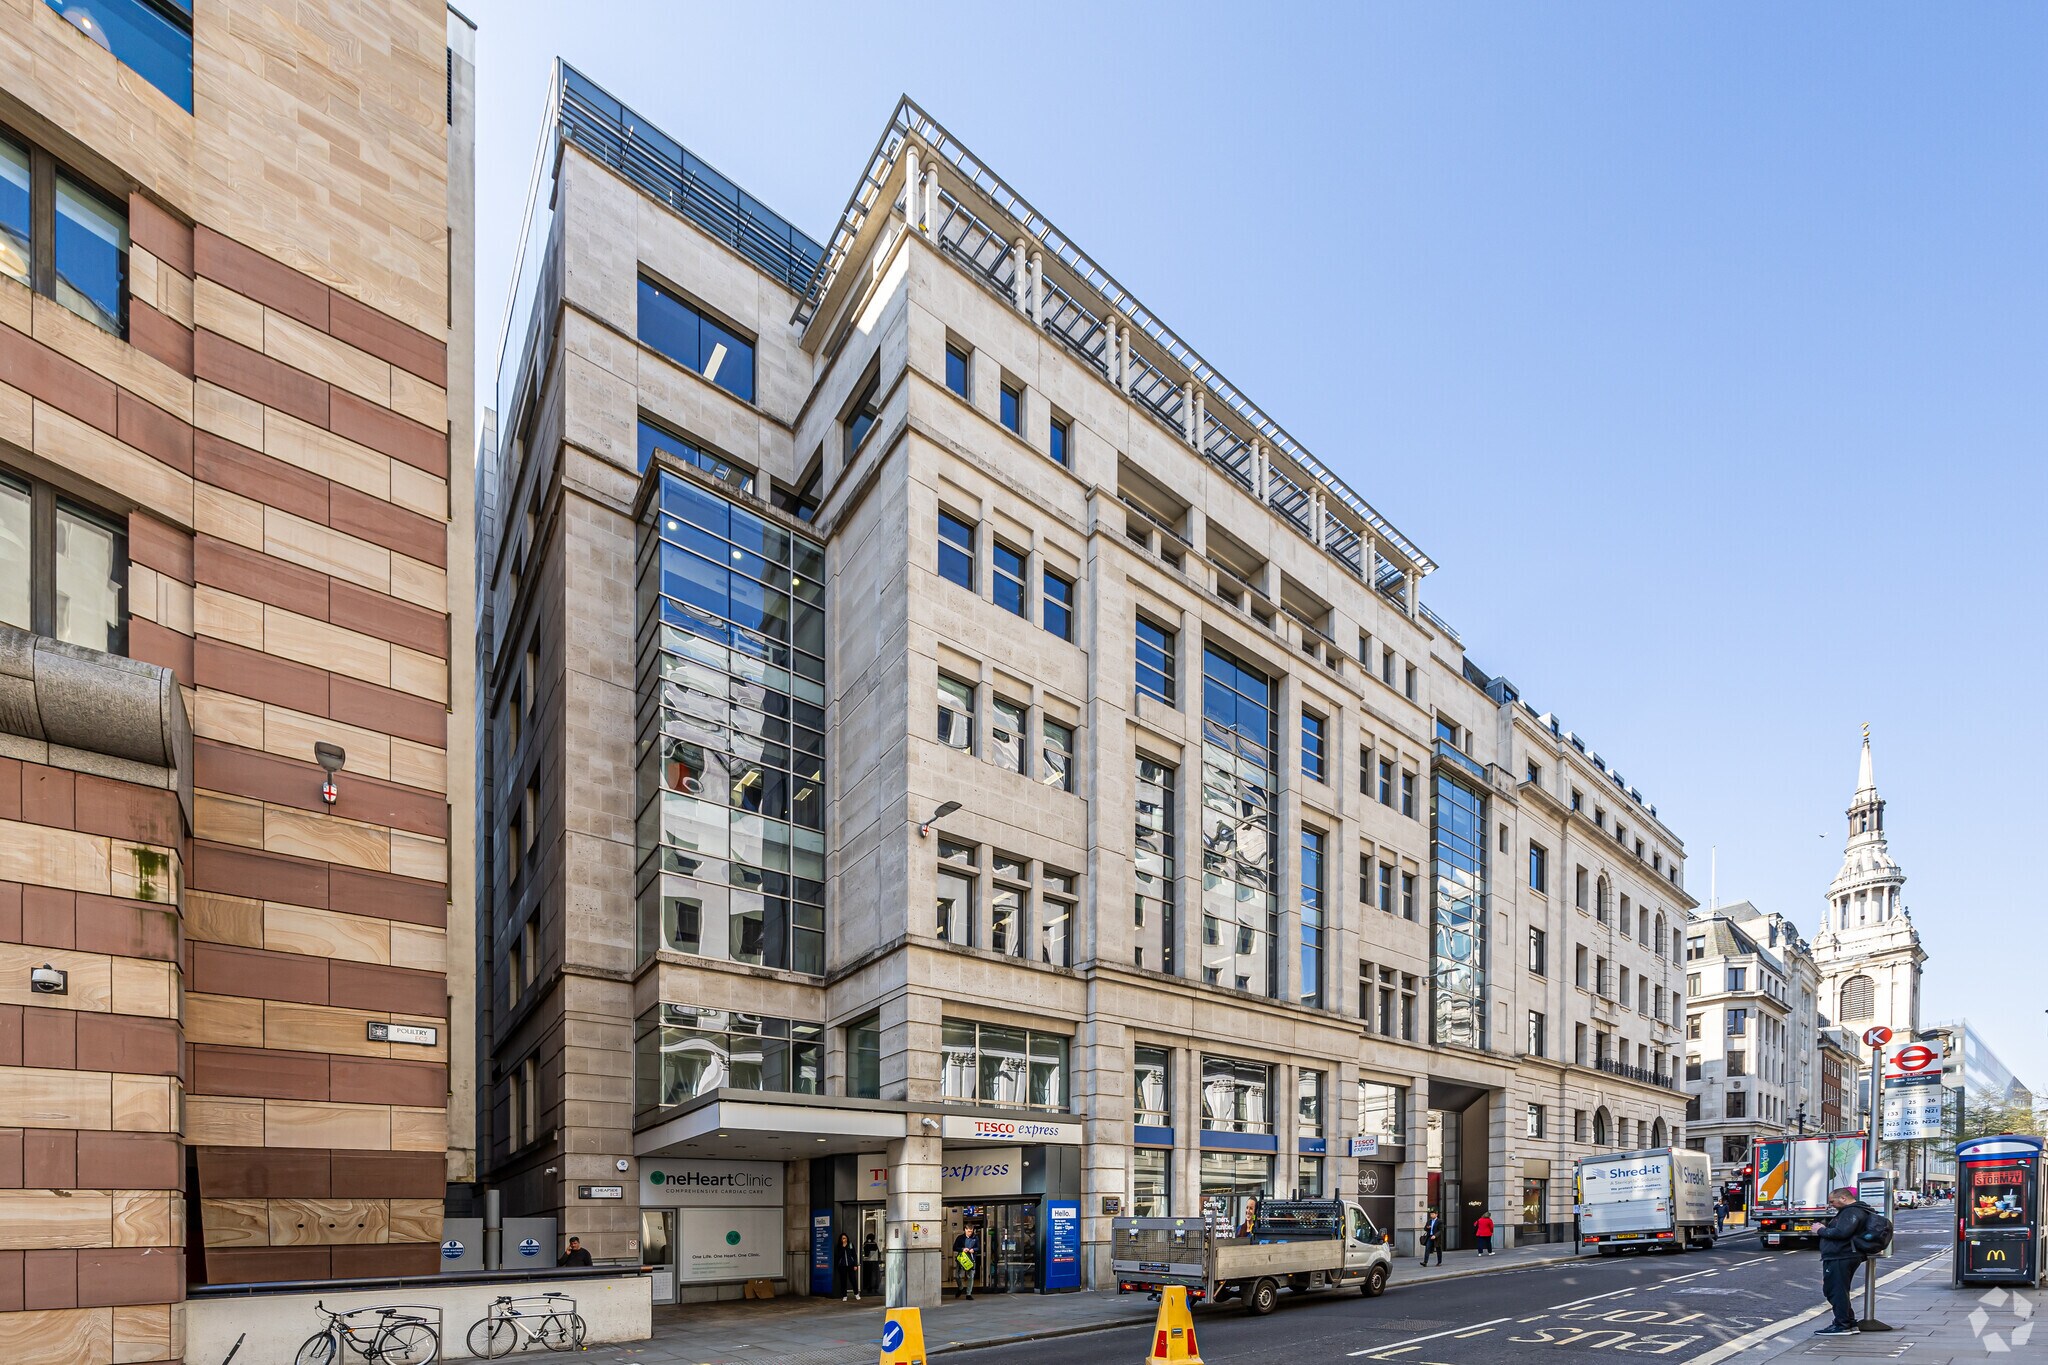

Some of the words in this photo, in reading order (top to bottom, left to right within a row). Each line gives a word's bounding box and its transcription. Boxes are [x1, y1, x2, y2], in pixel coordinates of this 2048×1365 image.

[396, 1028, 428, 1036] POULTRY
[1868, 1028, 1886, 1044] K
[975, 1122, 1015, 1133] TESCO
[1018, 1124, 1059, 1137] express
[942, 1164, 1009, 1181] express
[1684, 1166, 1704, 1185] Shred-it
[1976, 1175, 2020, 1185] STORMZY
[1359, 1176, 1376, 1187] eighty
[1558, 1310, 1774, 1329] STOP
[1508, 1328, 1704, 1354] BUS
